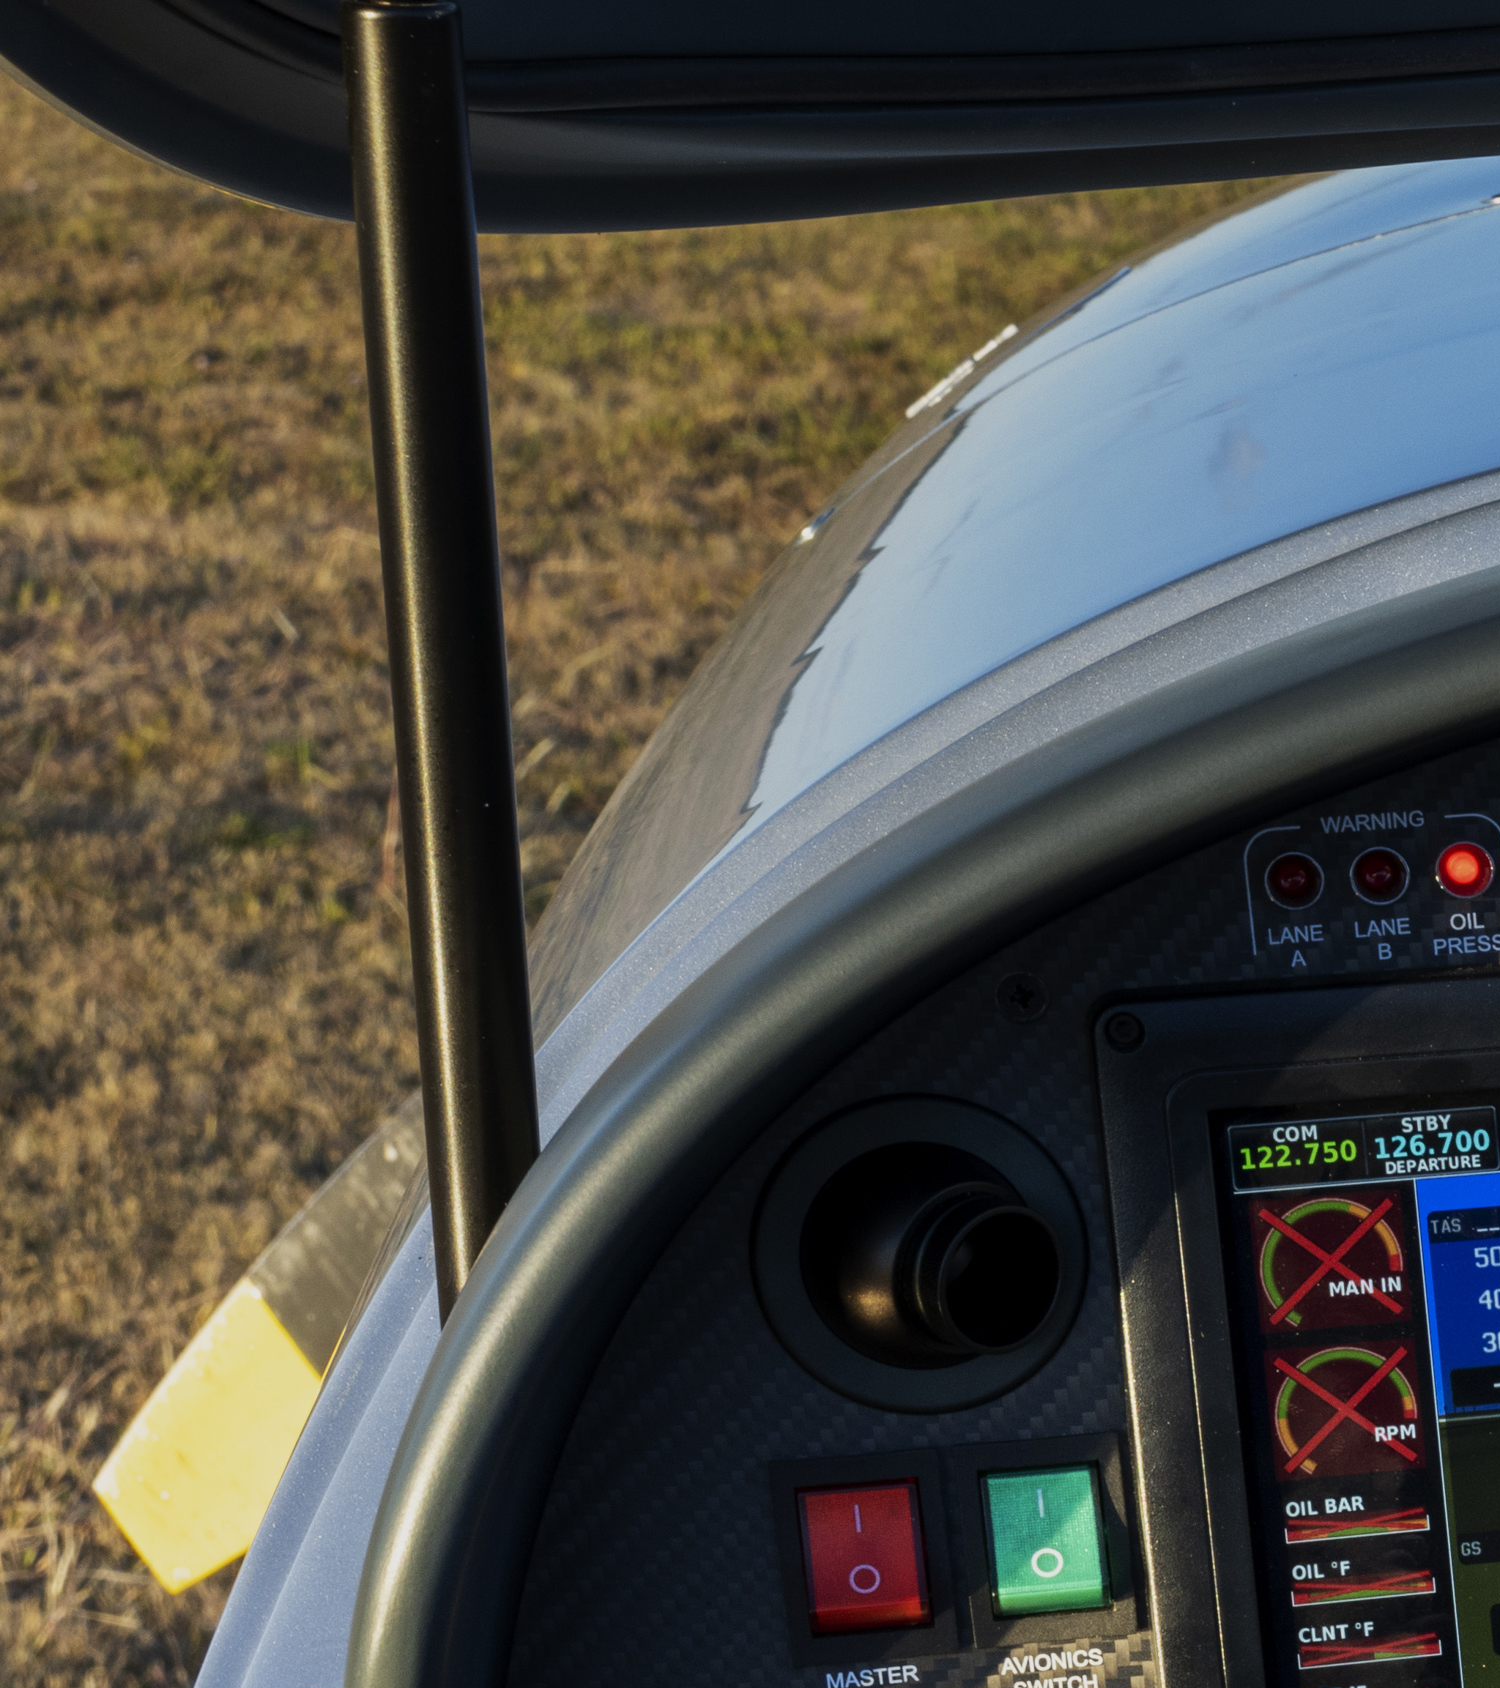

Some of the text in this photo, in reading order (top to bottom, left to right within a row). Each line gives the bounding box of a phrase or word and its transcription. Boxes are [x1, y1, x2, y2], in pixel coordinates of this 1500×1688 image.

[1320, 810, 1426, 836] WARNING
[1353, 917, 1412, 939] LANE
[1450, 912, 1486, 933] OIL
[1267, 924, 1324, 945] LANE
[1400, 1115, 1452, 1134] STBY
[1239, 1140, 1357, 1172] 122.750
[1374, 1129, 1491, 1161] 126.700
[1384, 1154, 1482, 1175] DEPARTURE
[1328, 1276, 1402, 1298] MAN IN
[1001, 1648, 1104, 1676] AVIONICS
